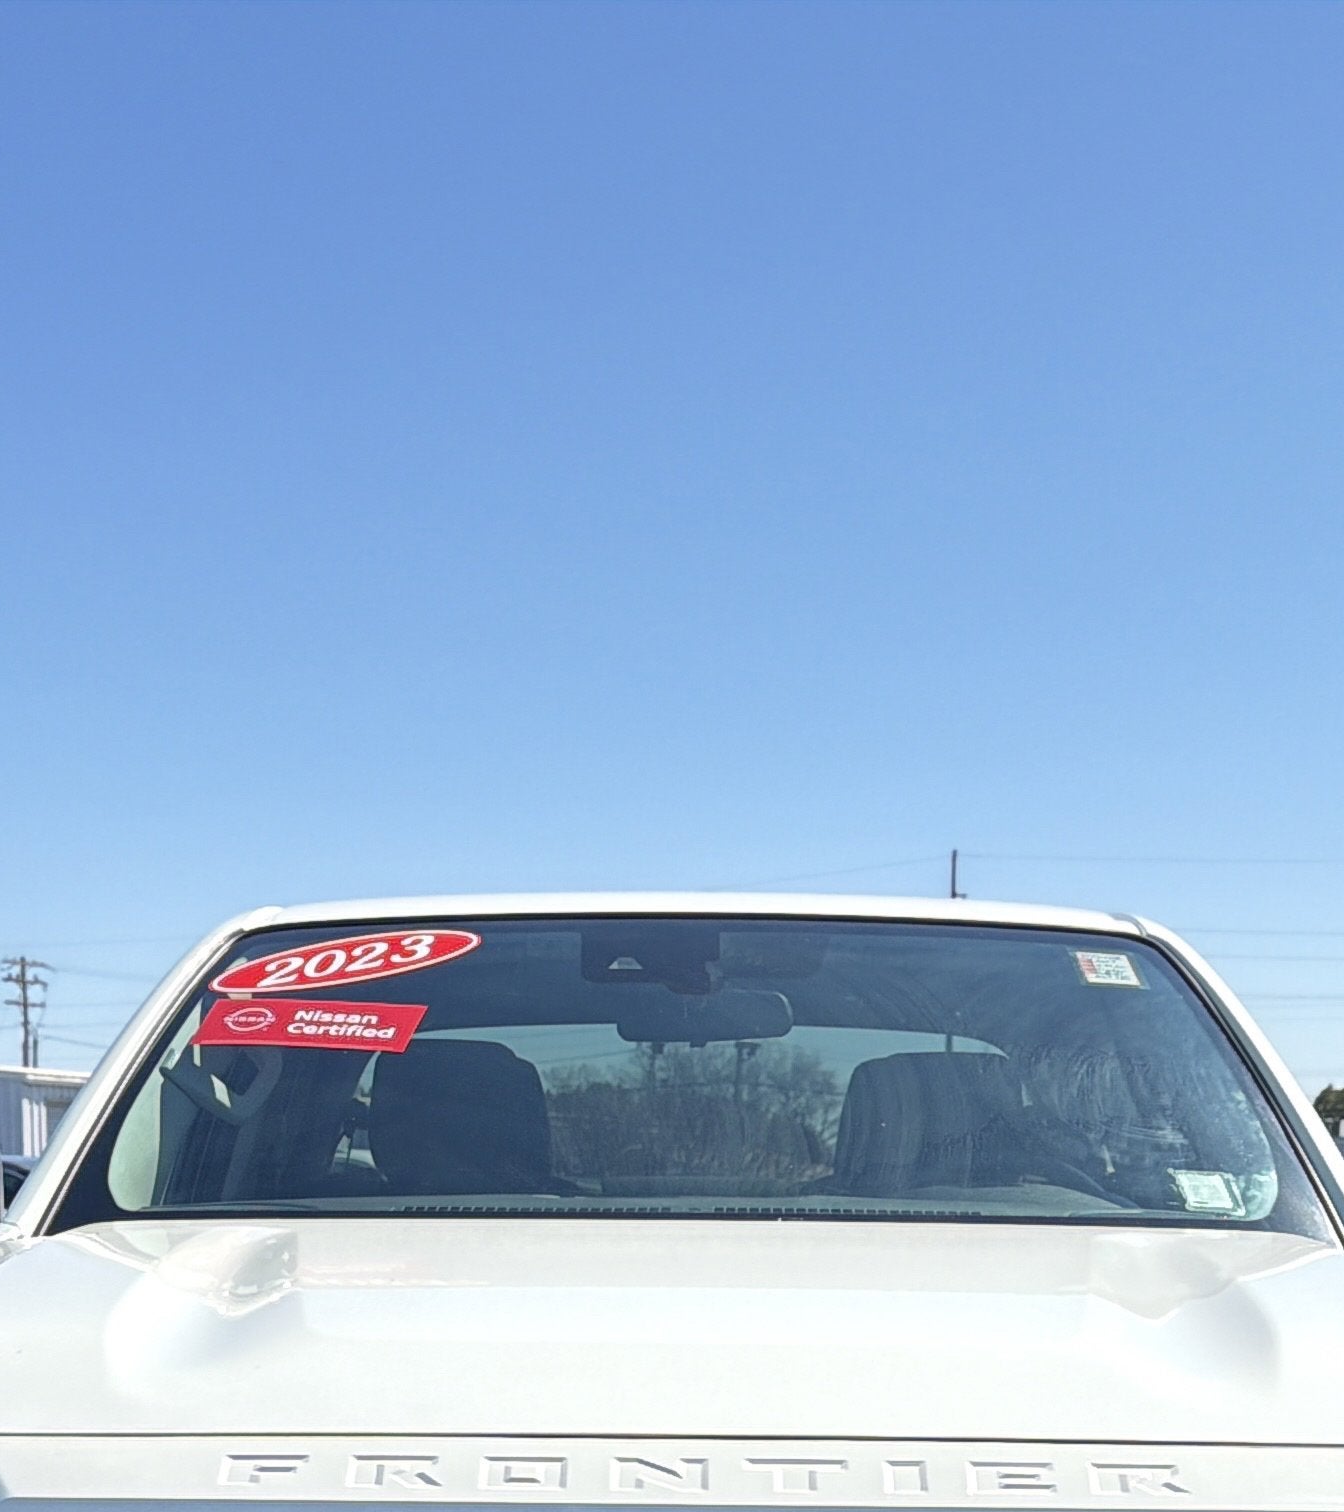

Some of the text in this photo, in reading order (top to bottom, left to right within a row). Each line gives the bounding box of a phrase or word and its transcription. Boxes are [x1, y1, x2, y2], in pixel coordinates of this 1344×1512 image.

[256, 934, 435, 988] 2023
[286, 1022, 396, 1040] Certified
[294, 1009, 379, 1025] Nissan
[217, 1451, 1194, 1496] FRONTIER
